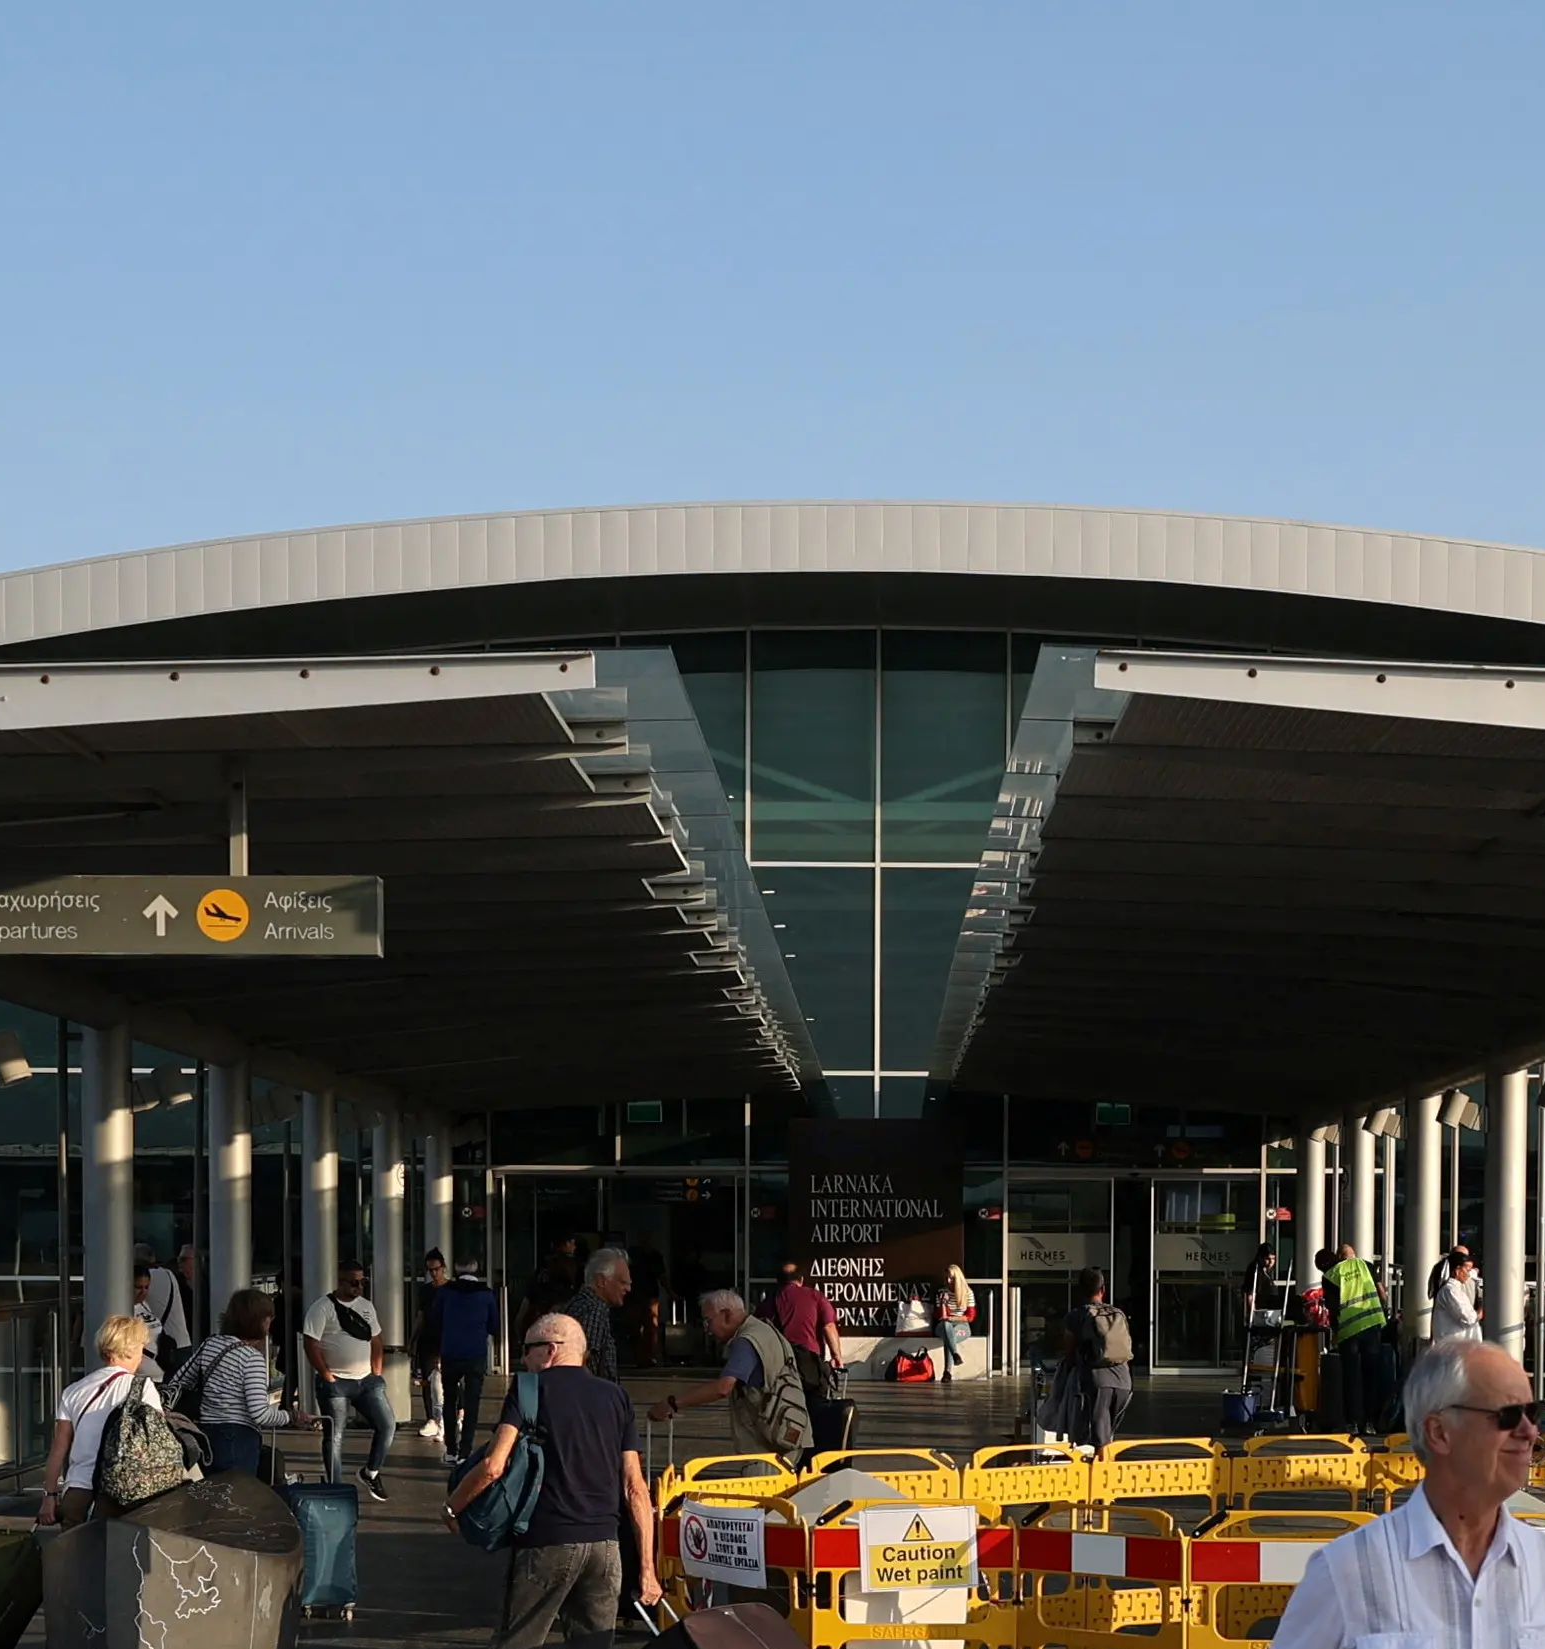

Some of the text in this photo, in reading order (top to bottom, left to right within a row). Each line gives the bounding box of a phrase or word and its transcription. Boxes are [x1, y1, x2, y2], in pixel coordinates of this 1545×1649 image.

[264, 890, 332, 914] Αφίξεις
[264, 922, 334, 940] Arrivals
[810, 1174, 894, 1193] LARNAKA
[810, 1199, 944, 1218] INTERNATIONAL
[810, 1224, 883, 1243] AIRPORT
[810, 1258, 884, 1277] ΔΙΕΘΝΗΣ
[1020, 1251, 1066, 1266] HERMES
[1185, 1251, 1231, 1266] HERMES
[882, 1545, 956, 1563] Caution
[876, 1564, 963, 1584] Wet paint
